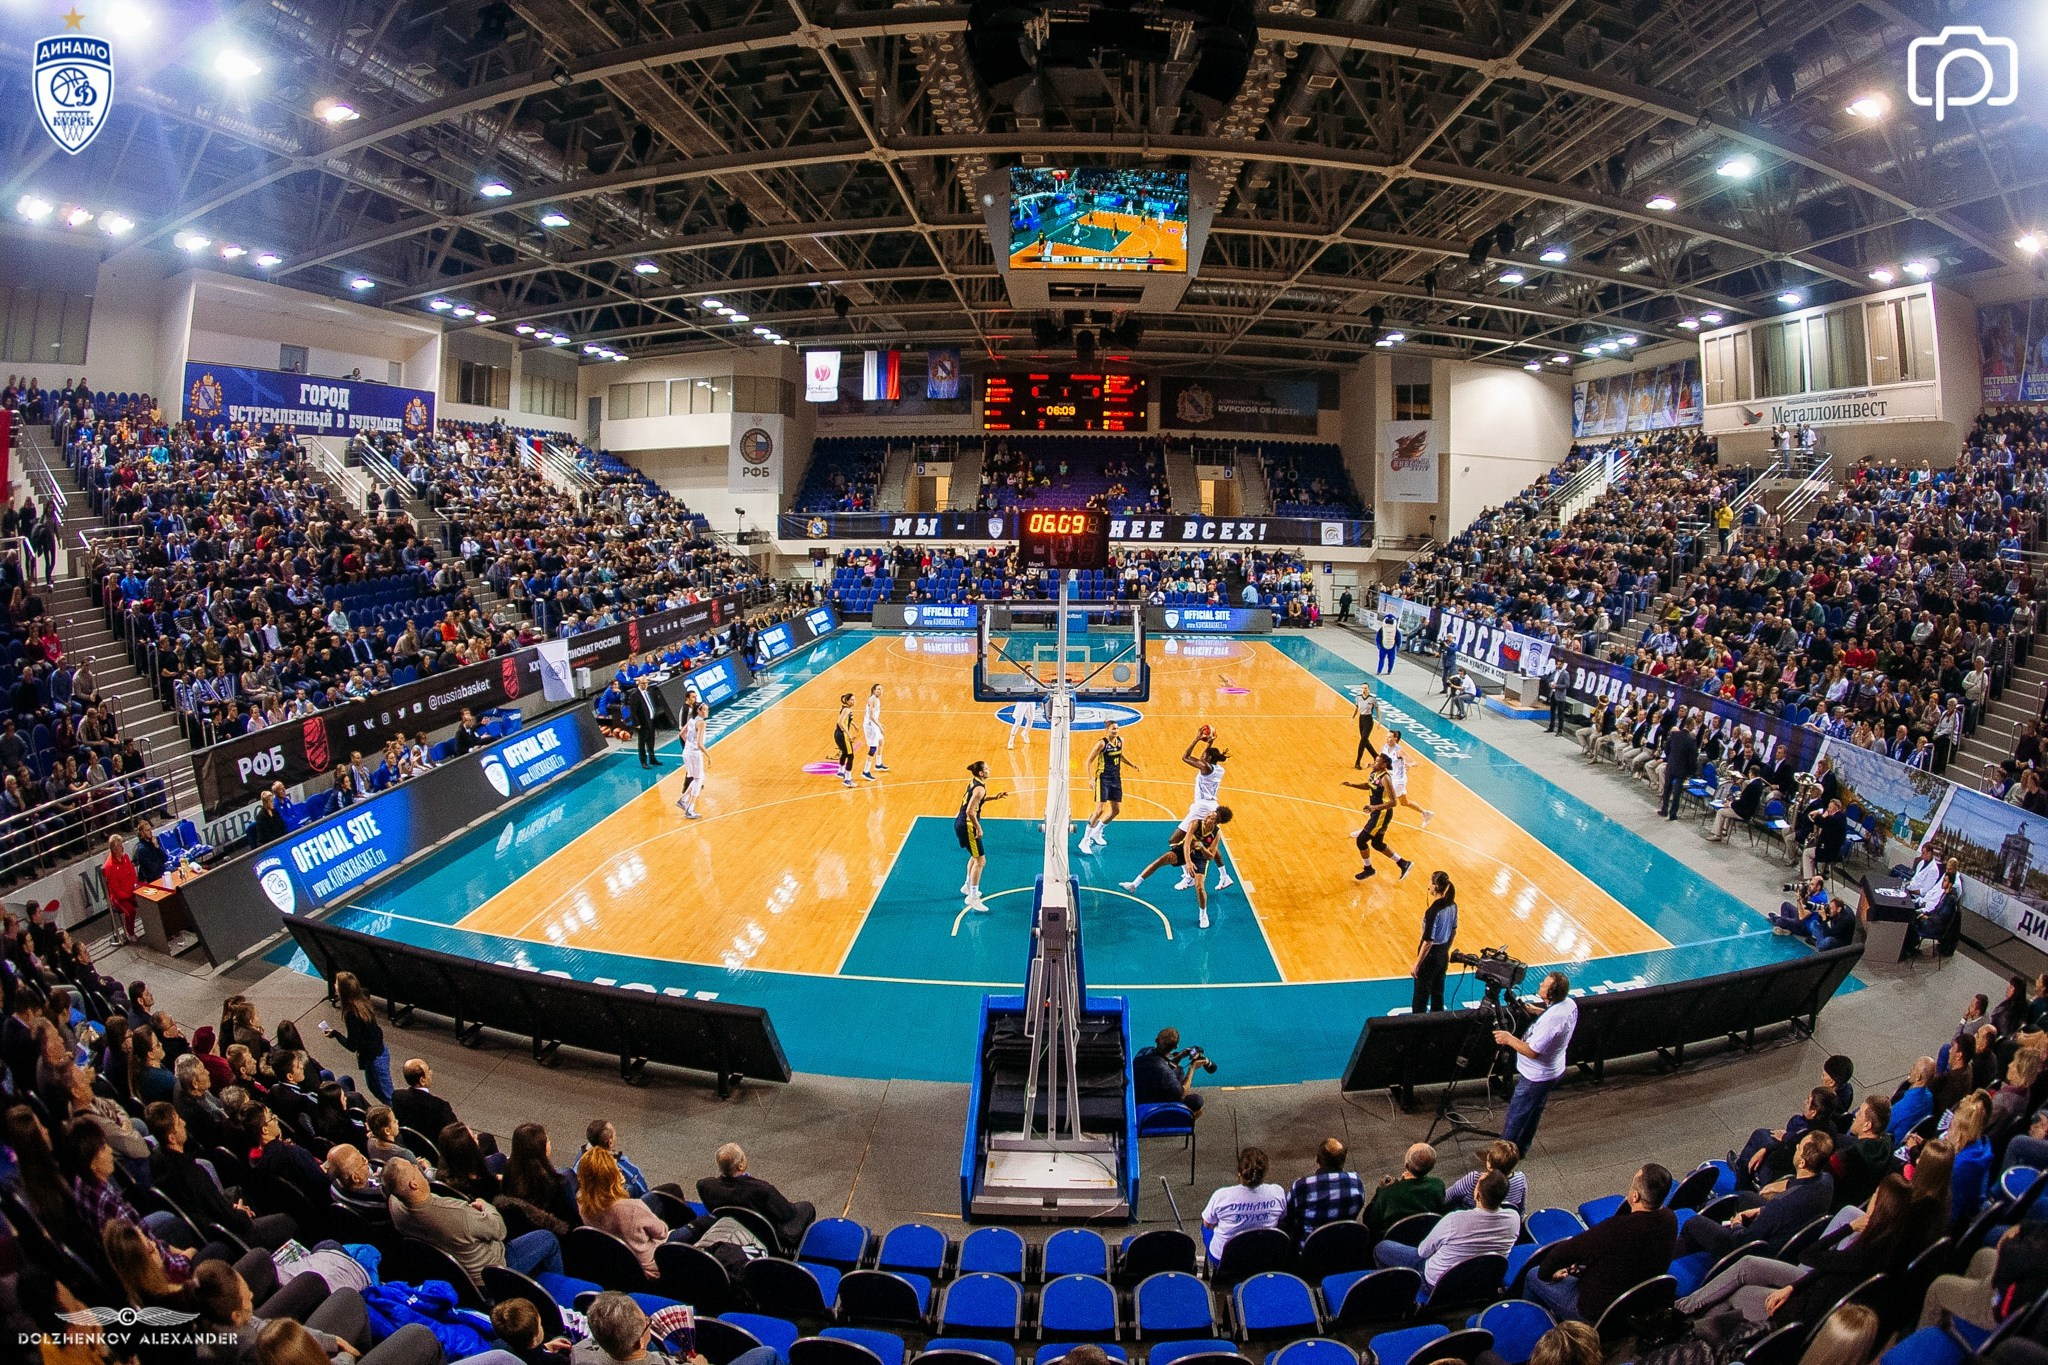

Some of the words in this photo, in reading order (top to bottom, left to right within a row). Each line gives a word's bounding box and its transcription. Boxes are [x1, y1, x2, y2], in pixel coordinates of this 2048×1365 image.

[300, 383, 350, 411] ГОРОД
[228, 405, 332, 428] УСТРЕМЛЕННЫЙ
[336, 414, 345, 429] В
[349, 414, 402, 433] БУДУЩЕЕ!
[1046, 405, 1076, 416] 06:09
[1218, 404, 1258, 413] КУРСКОЙ
[1259, 407, 1300, 415] ОБЛАСТИ
[1771, 401, 1887, 424] Металлоинвест
[742, 466, 770, 478] РФБ
[893, 518, 938, 536] МЫ
[1183, 522, 1267, 541] ВСЕХ!
[922, 607, 952, 617] OFFICIAL
[953, 607, 969, 617] SITE
[1184, 610, 1214, 620] OFFICIAL
[1215, 611, 1230, 620] SITE
[594, 635, 621, 652] РОССИИ
[1438, 613, 1505, 666] КУРСК
[428, 678, 490, 710] @russiabasket
[503, 736, 545, 768] OFFICIAL
[537, 728, 561, 752] SITE
[237, 745, 285, 784] РФБ
[291, 825, 354, 873] OFFICIAL
[347, 811, 382, 845] SITE
[311, 847, 387, 898] www.KURSKBASKET.ru
[1230, 1200, 1276, 1211] ДИНАМО
